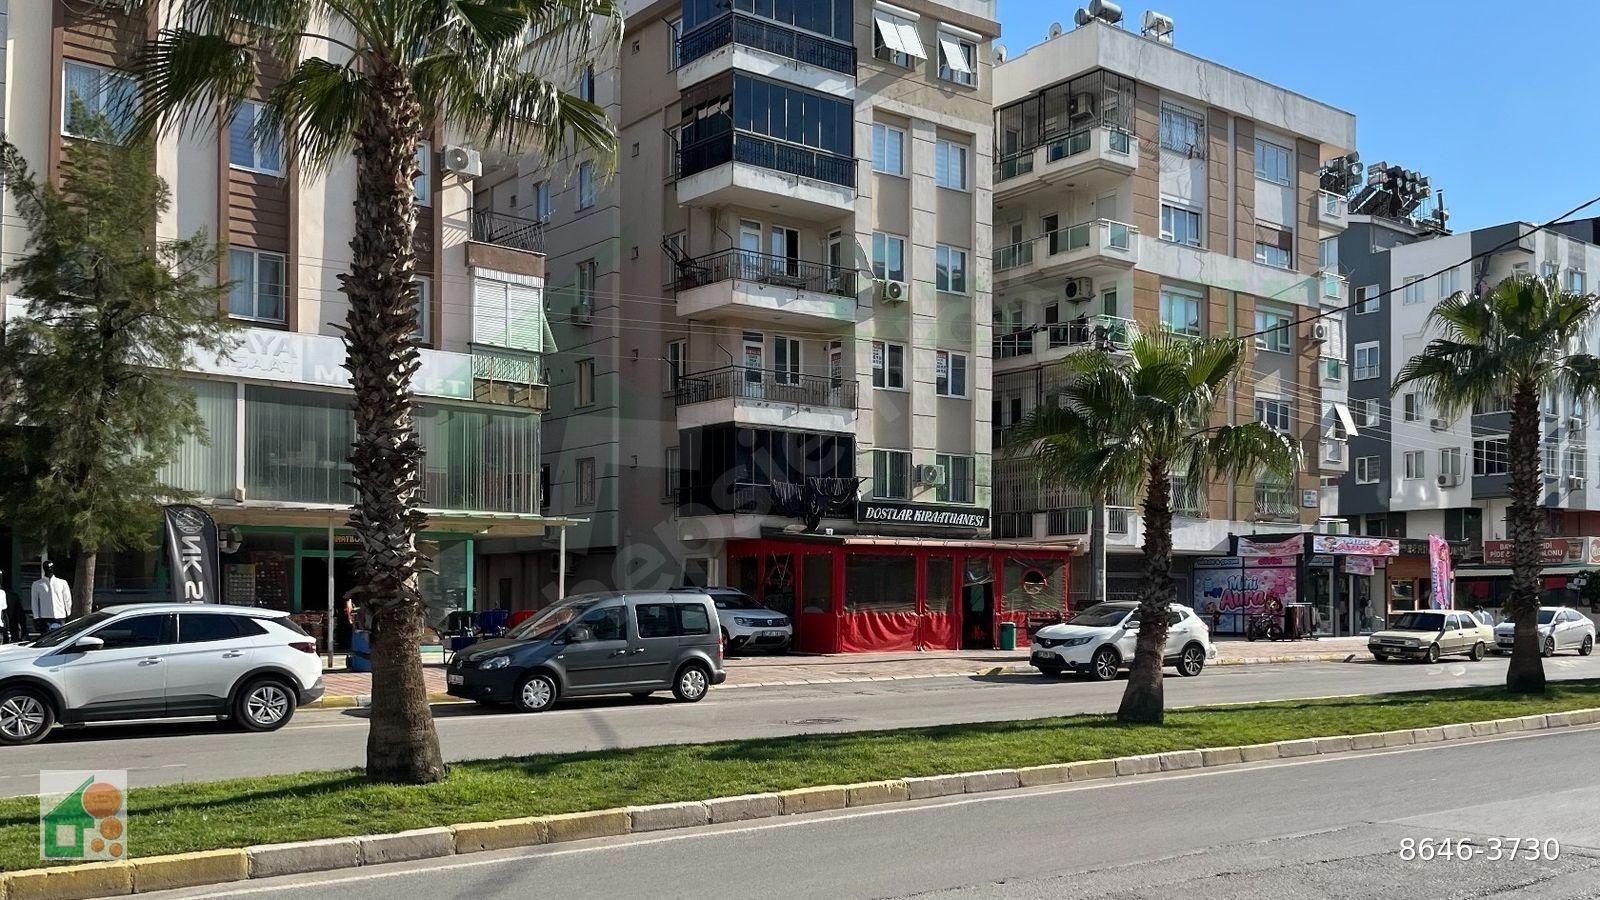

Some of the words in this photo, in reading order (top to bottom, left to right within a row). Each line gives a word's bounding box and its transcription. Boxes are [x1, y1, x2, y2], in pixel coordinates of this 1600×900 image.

[865, 507, 913, 521] DOSTLAR
[1227, 575, 1258, 591] Mni
[1220, 589, 1267, 612] Aura
